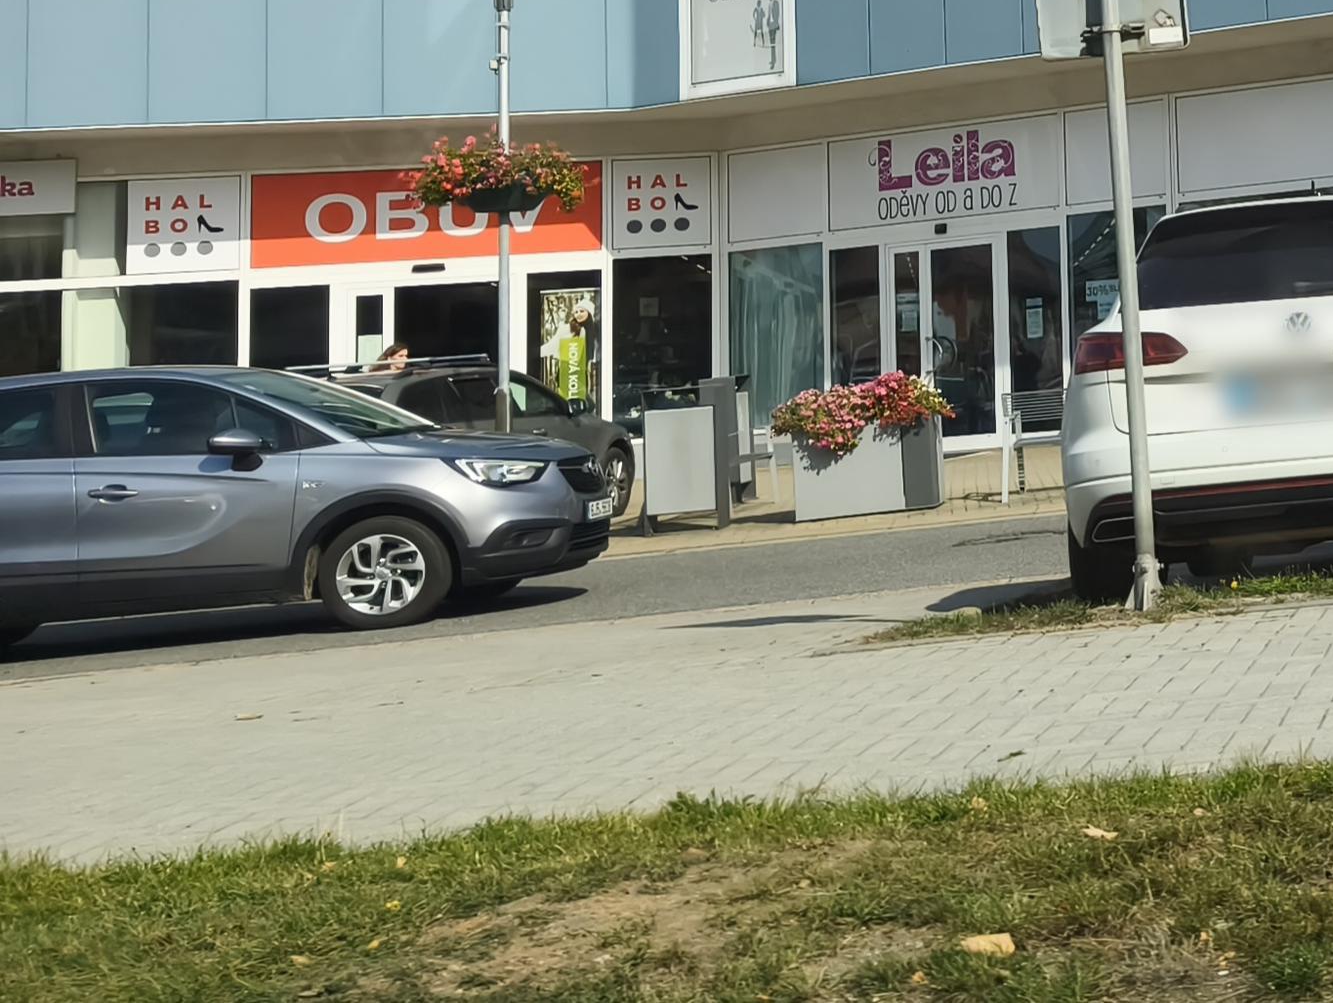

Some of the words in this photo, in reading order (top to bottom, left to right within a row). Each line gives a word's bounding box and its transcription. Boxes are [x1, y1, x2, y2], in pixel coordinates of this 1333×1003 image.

[868, 130, 1016, 192] Leila
[627, 173, 687, 190] HAL
[145, 194, 212, 212] HAL
[935, 189, 957, 215] OD
[980, 184, 1002, 209] DO
[1008, 182, 1018, 207] Z
